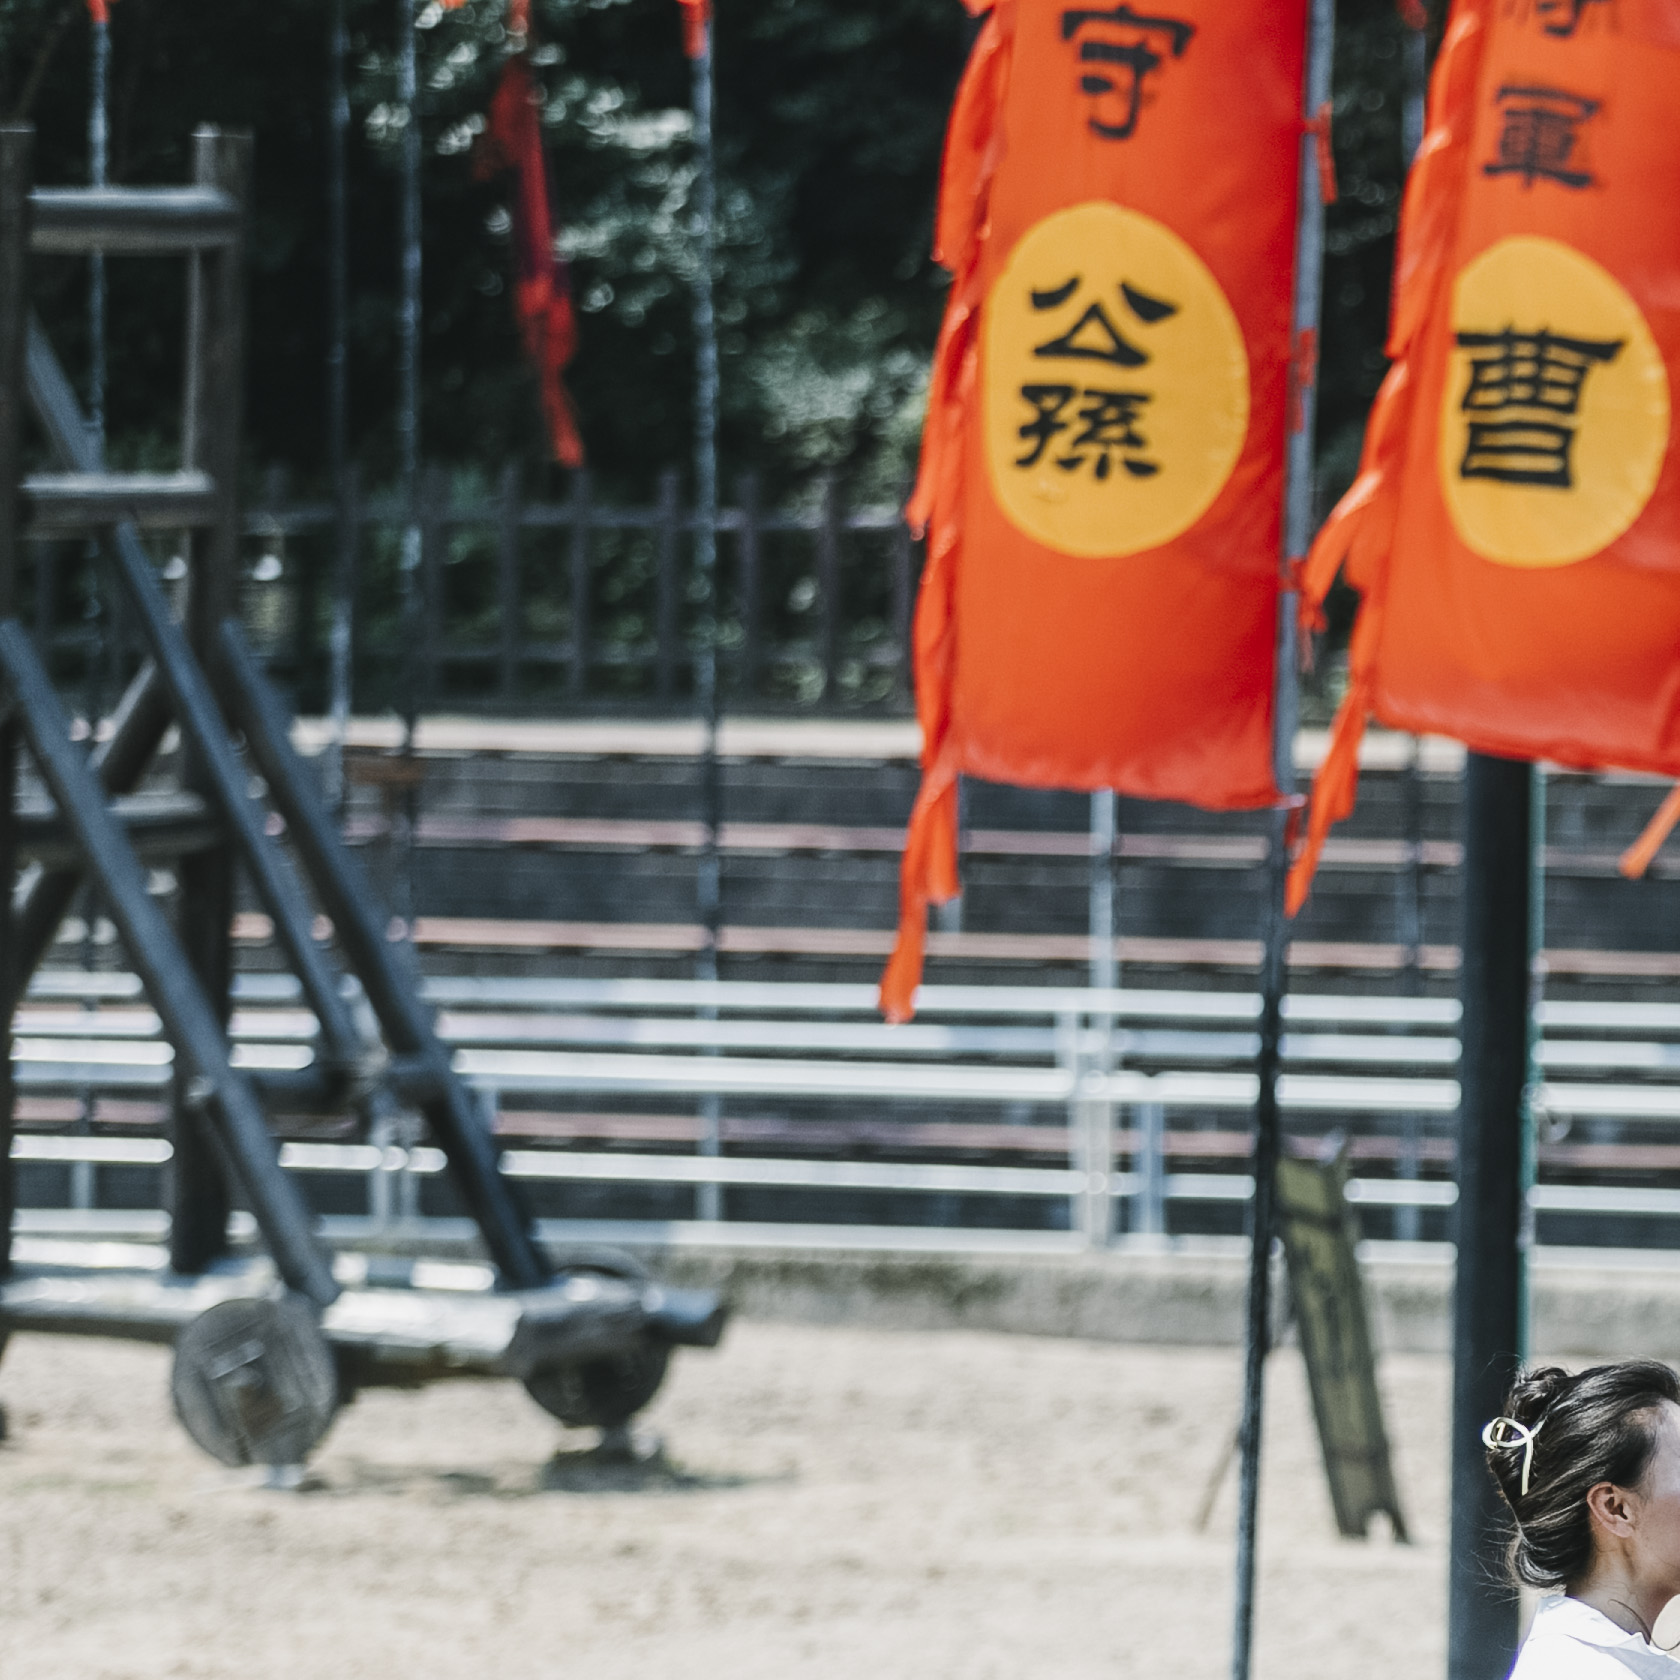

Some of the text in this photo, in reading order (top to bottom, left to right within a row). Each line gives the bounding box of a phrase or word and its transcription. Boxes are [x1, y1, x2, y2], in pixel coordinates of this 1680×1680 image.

[1014, 4, 1197, 482] 守 公孫
[1455, 322, 1628, 488] 曹
